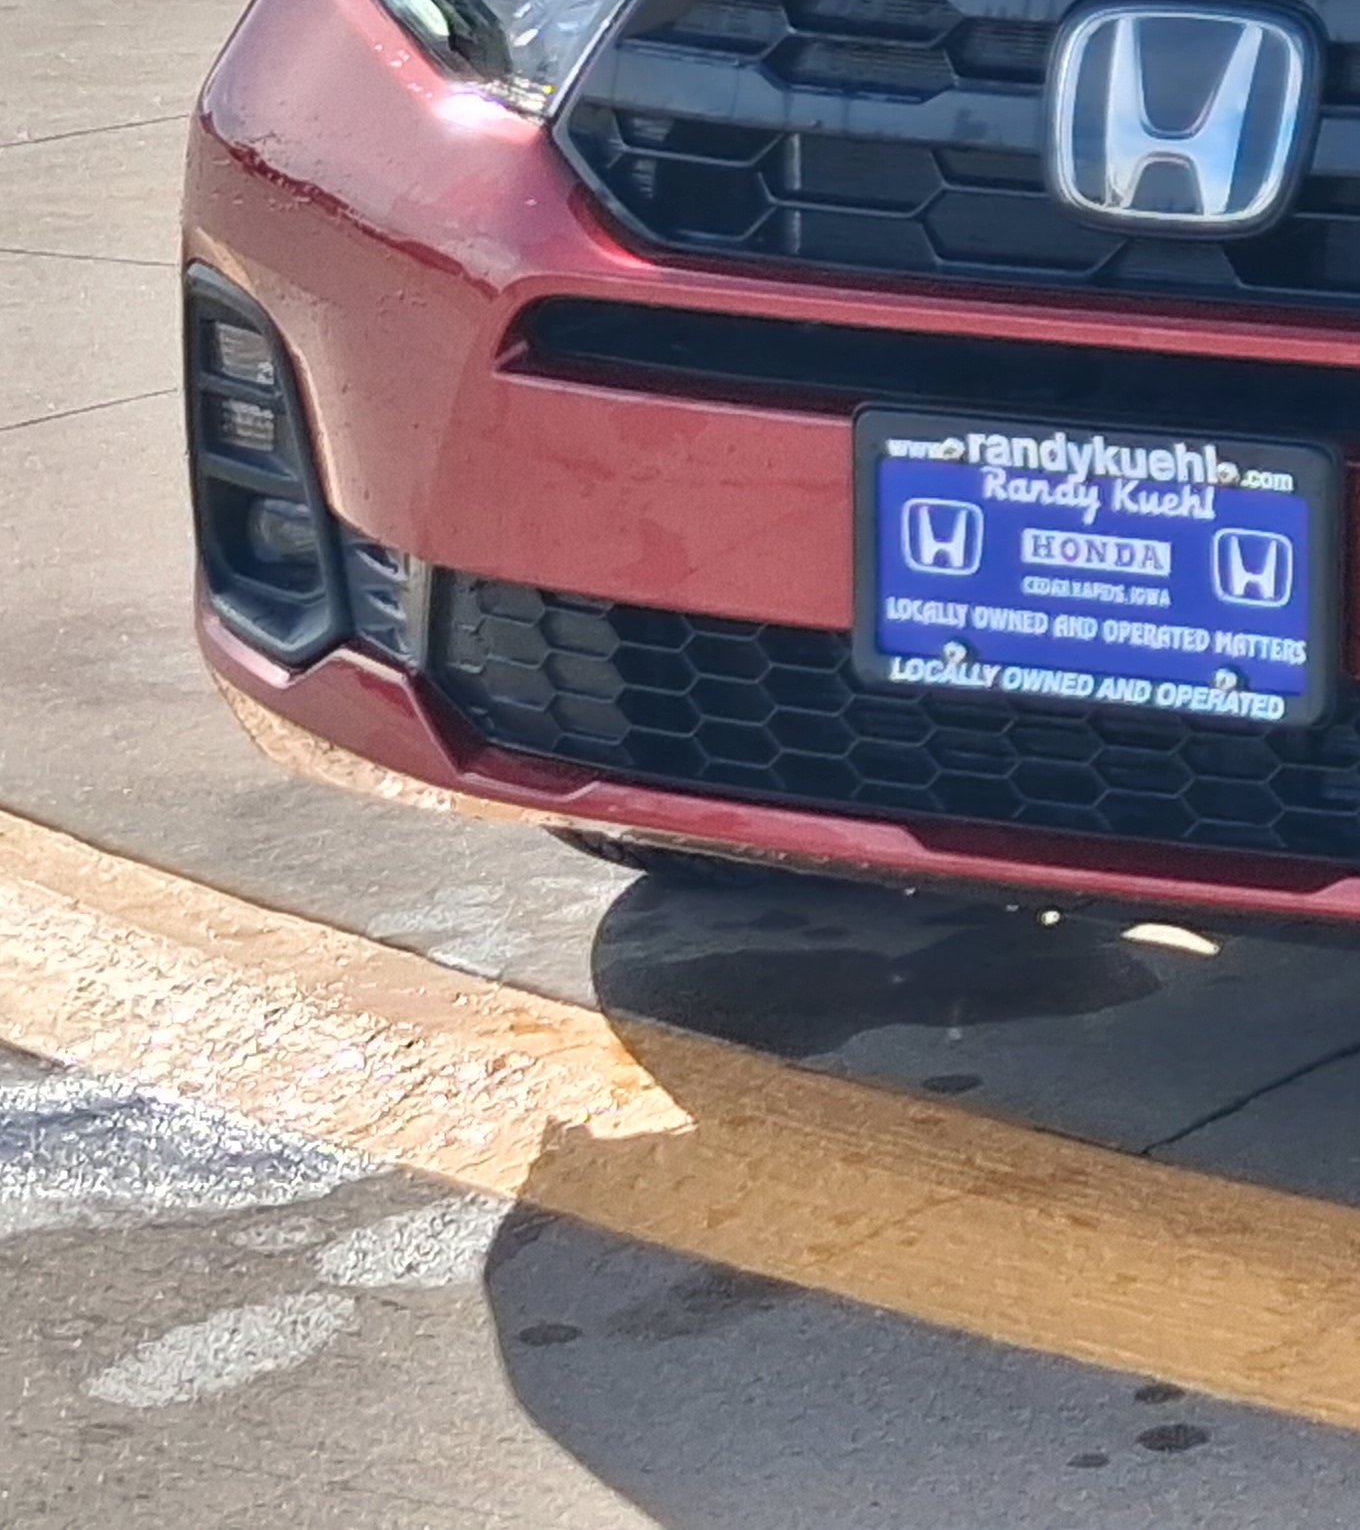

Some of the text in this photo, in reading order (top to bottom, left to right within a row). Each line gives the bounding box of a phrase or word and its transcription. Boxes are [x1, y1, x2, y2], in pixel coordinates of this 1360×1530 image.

[980, 465, 1216, 525] Randy Kuehl
[1031, 534, 1164, 571] HONDA
[886, 596, 1307, 665] LOCALLY OWNED AND OPERATED MATTERS
[889, 656, 1285, 721] LOCALLY OWNED AND OPERATED
